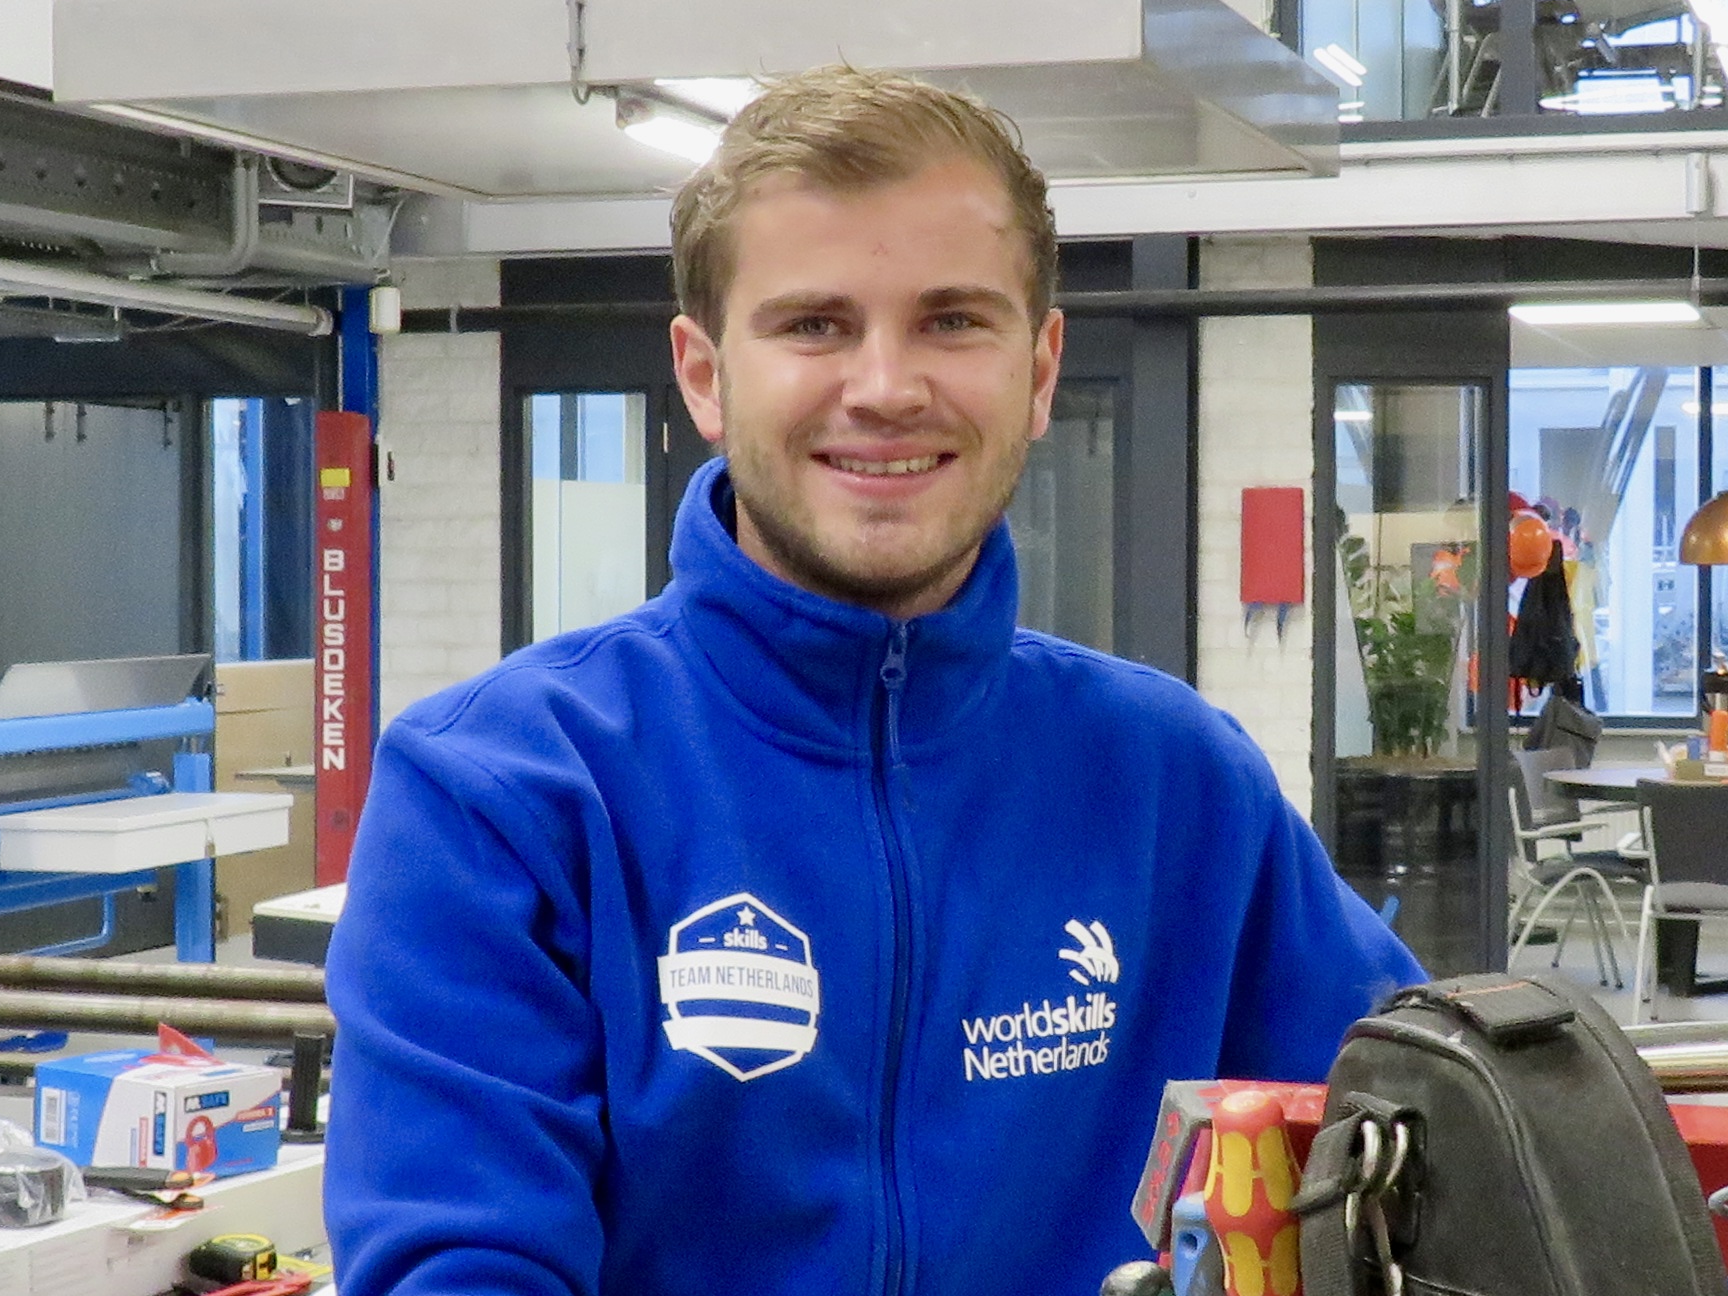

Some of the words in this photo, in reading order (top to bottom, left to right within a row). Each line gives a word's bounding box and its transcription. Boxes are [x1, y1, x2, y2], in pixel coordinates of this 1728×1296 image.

[322, 549, 346, 771] BLUSDEKEN
[723, 927, 768, 950] skills
[669, 965, 712, 989] TEAM
[716, 965, 814, 999] NETHERLANDS
[961, 991, 1116, 1045] worldskills
[963, 1030, 1111, 1082] Netherlands
